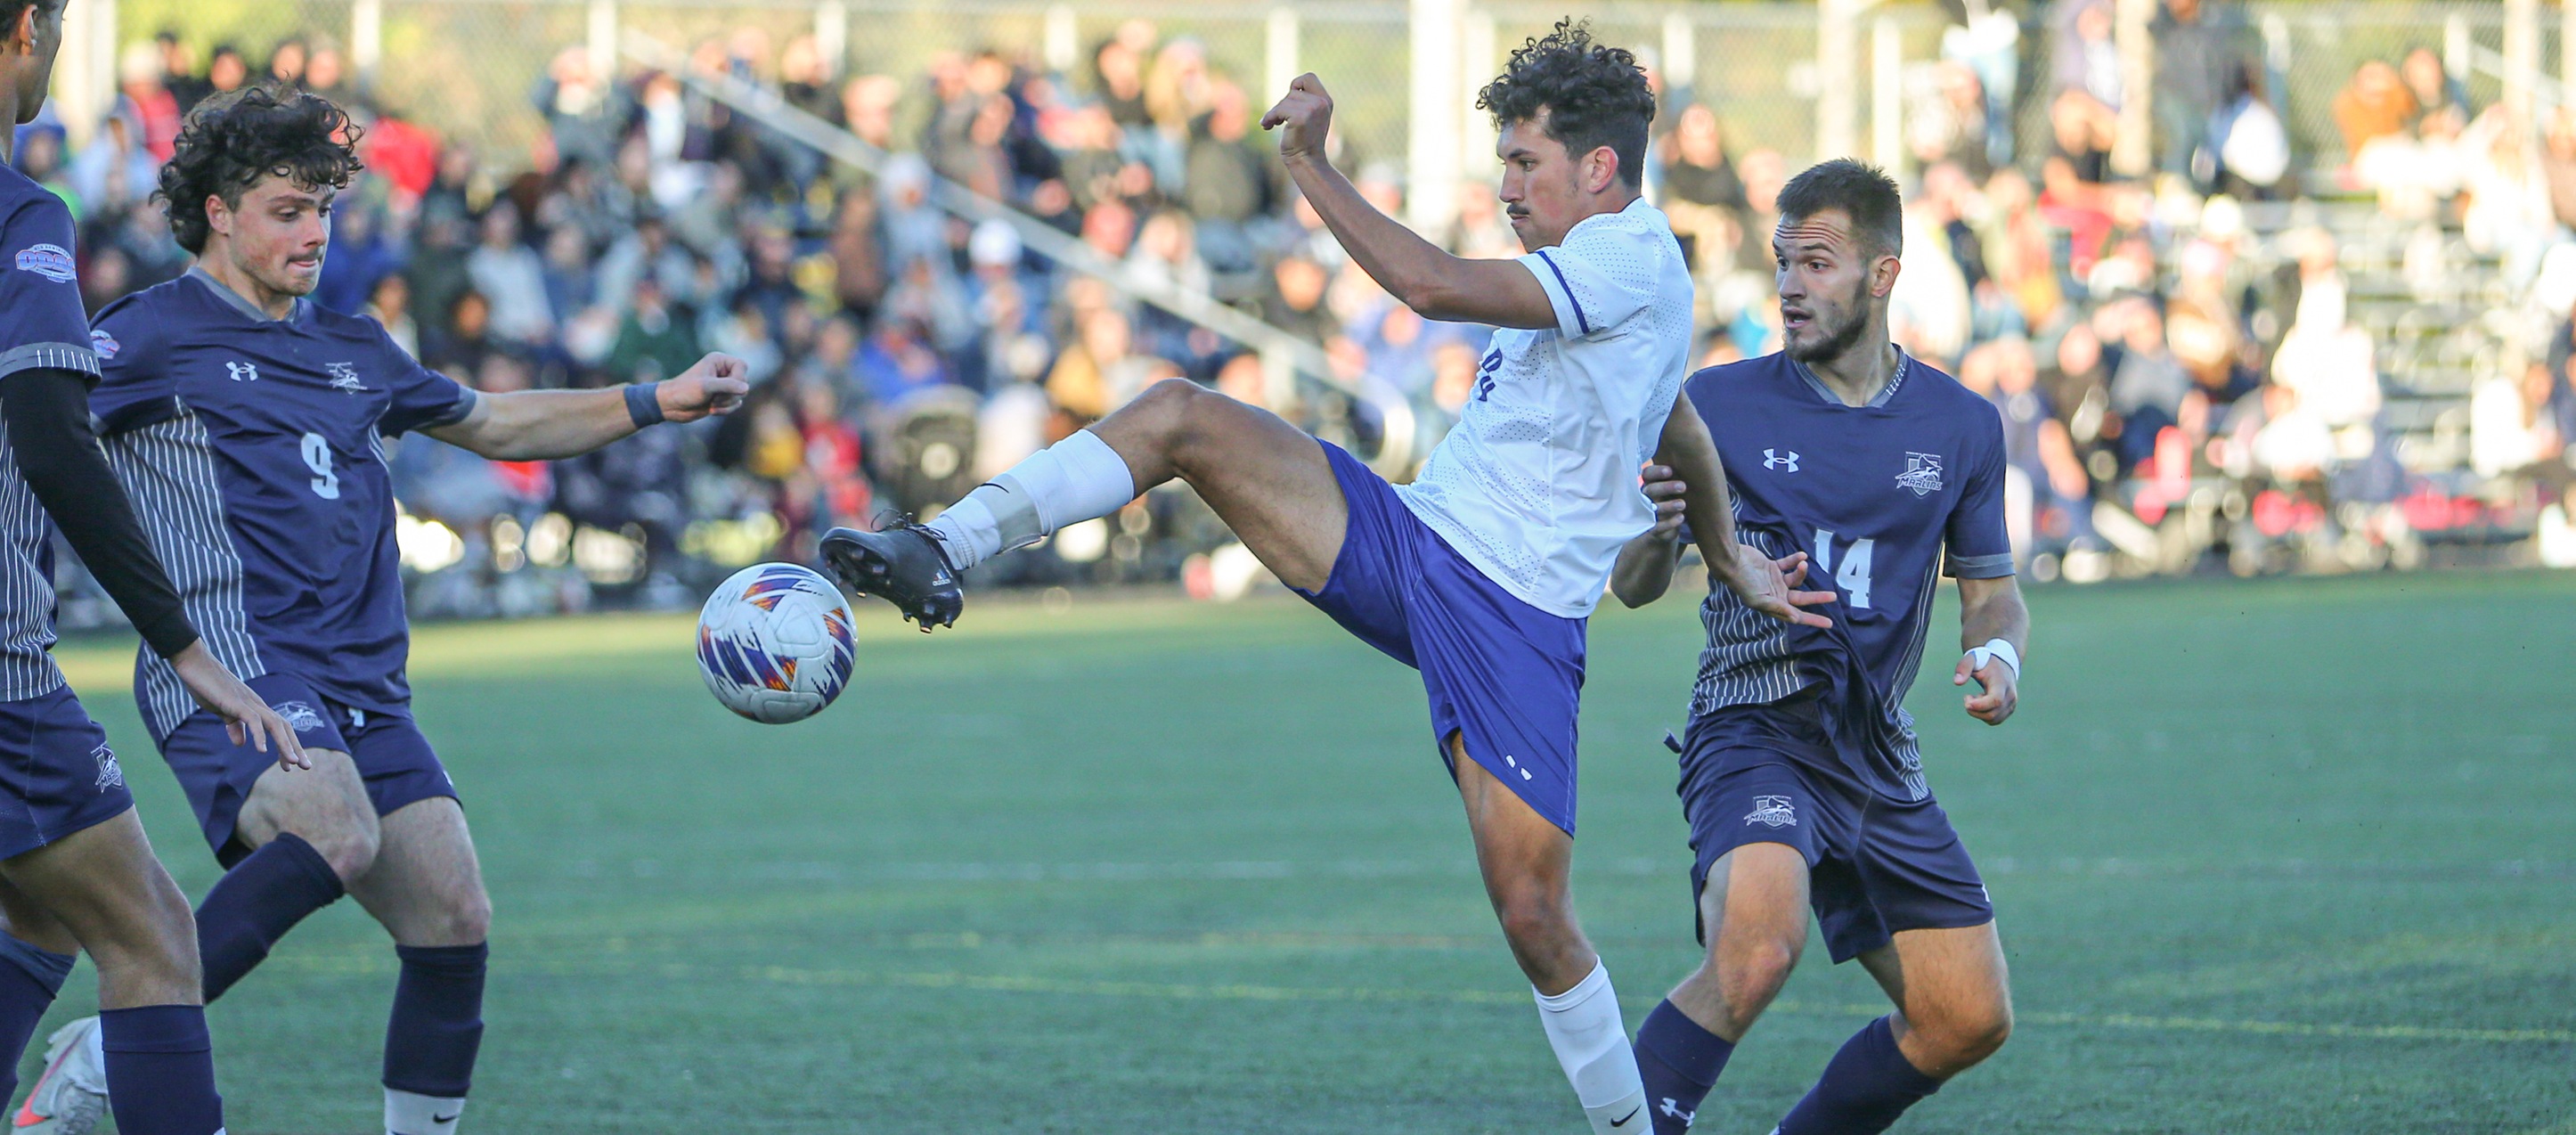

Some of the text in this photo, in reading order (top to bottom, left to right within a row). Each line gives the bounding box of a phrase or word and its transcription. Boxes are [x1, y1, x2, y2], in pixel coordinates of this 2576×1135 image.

[300, 431, 340, 500] 9
[932, 578, 951, 586] adidas
[1814, 528, 1874, 609] 14
